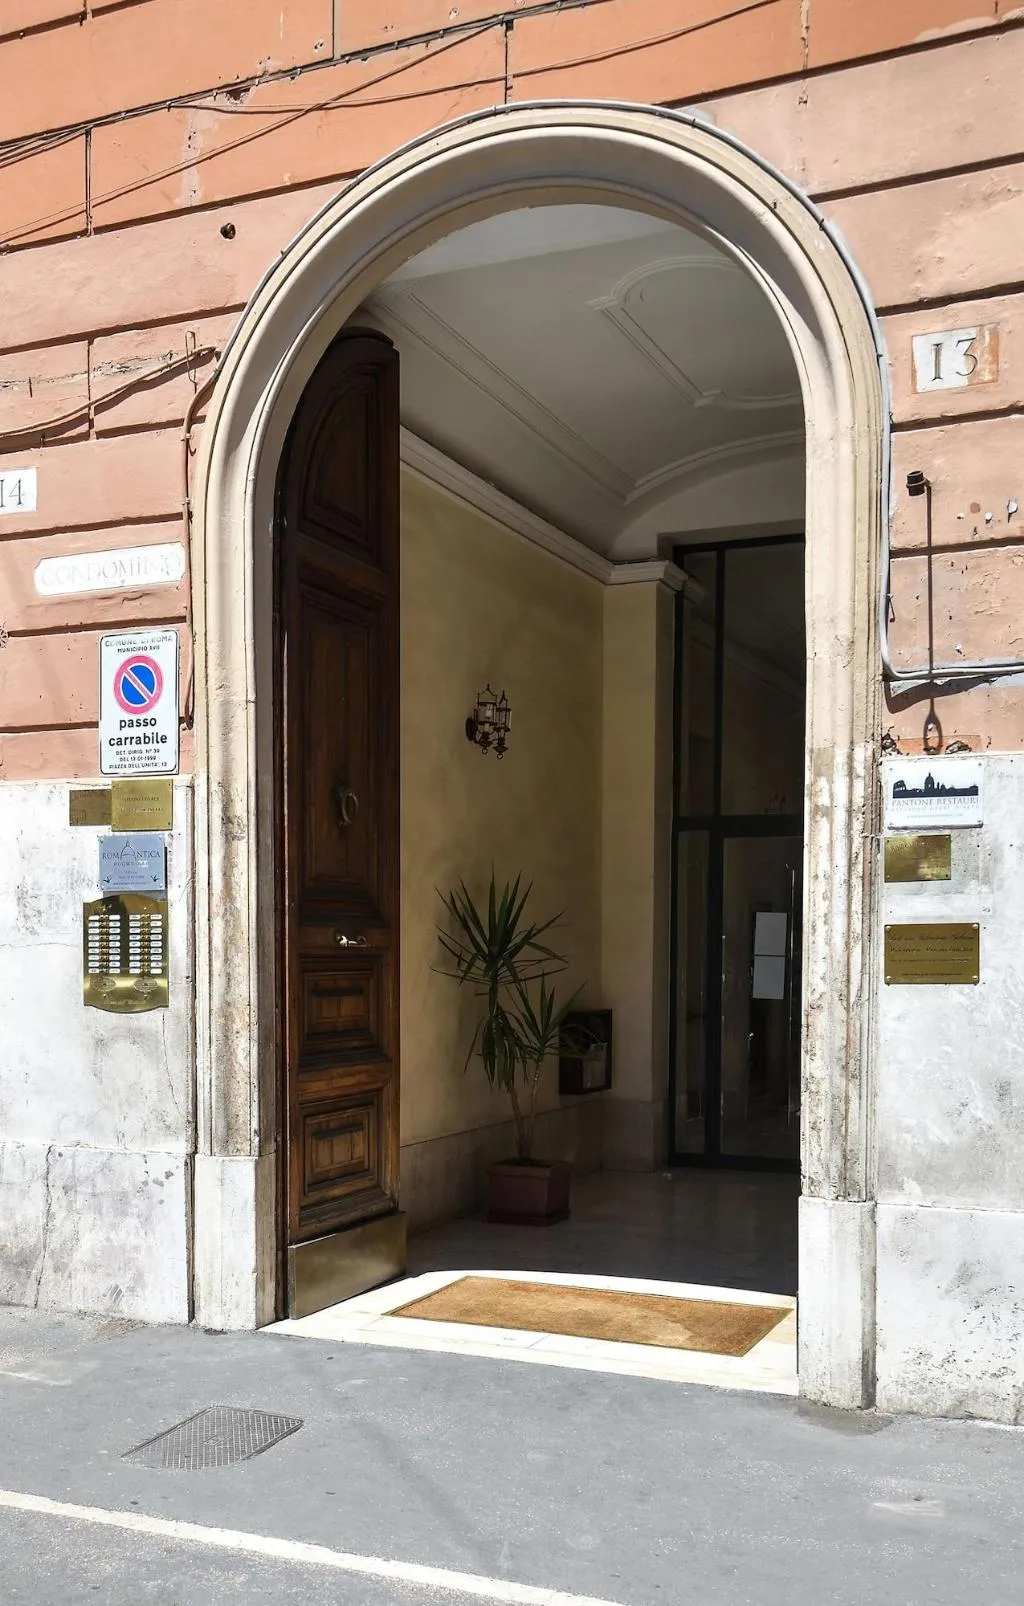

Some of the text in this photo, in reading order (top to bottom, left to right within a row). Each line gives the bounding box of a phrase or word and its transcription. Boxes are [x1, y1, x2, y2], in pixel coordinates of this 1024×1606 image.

[932, 337, 978, 381] 13
[41, 552, 181, 586] CONDOMINIO
[105, 638, 138, 647] COMUNE
[151, 635, 173, 643] ROMA
[119, 717, 157, 730] passo
[108, 732, 168, 746] carrabile
[891, 796, 979, 807] PANTONE RESTAURI
